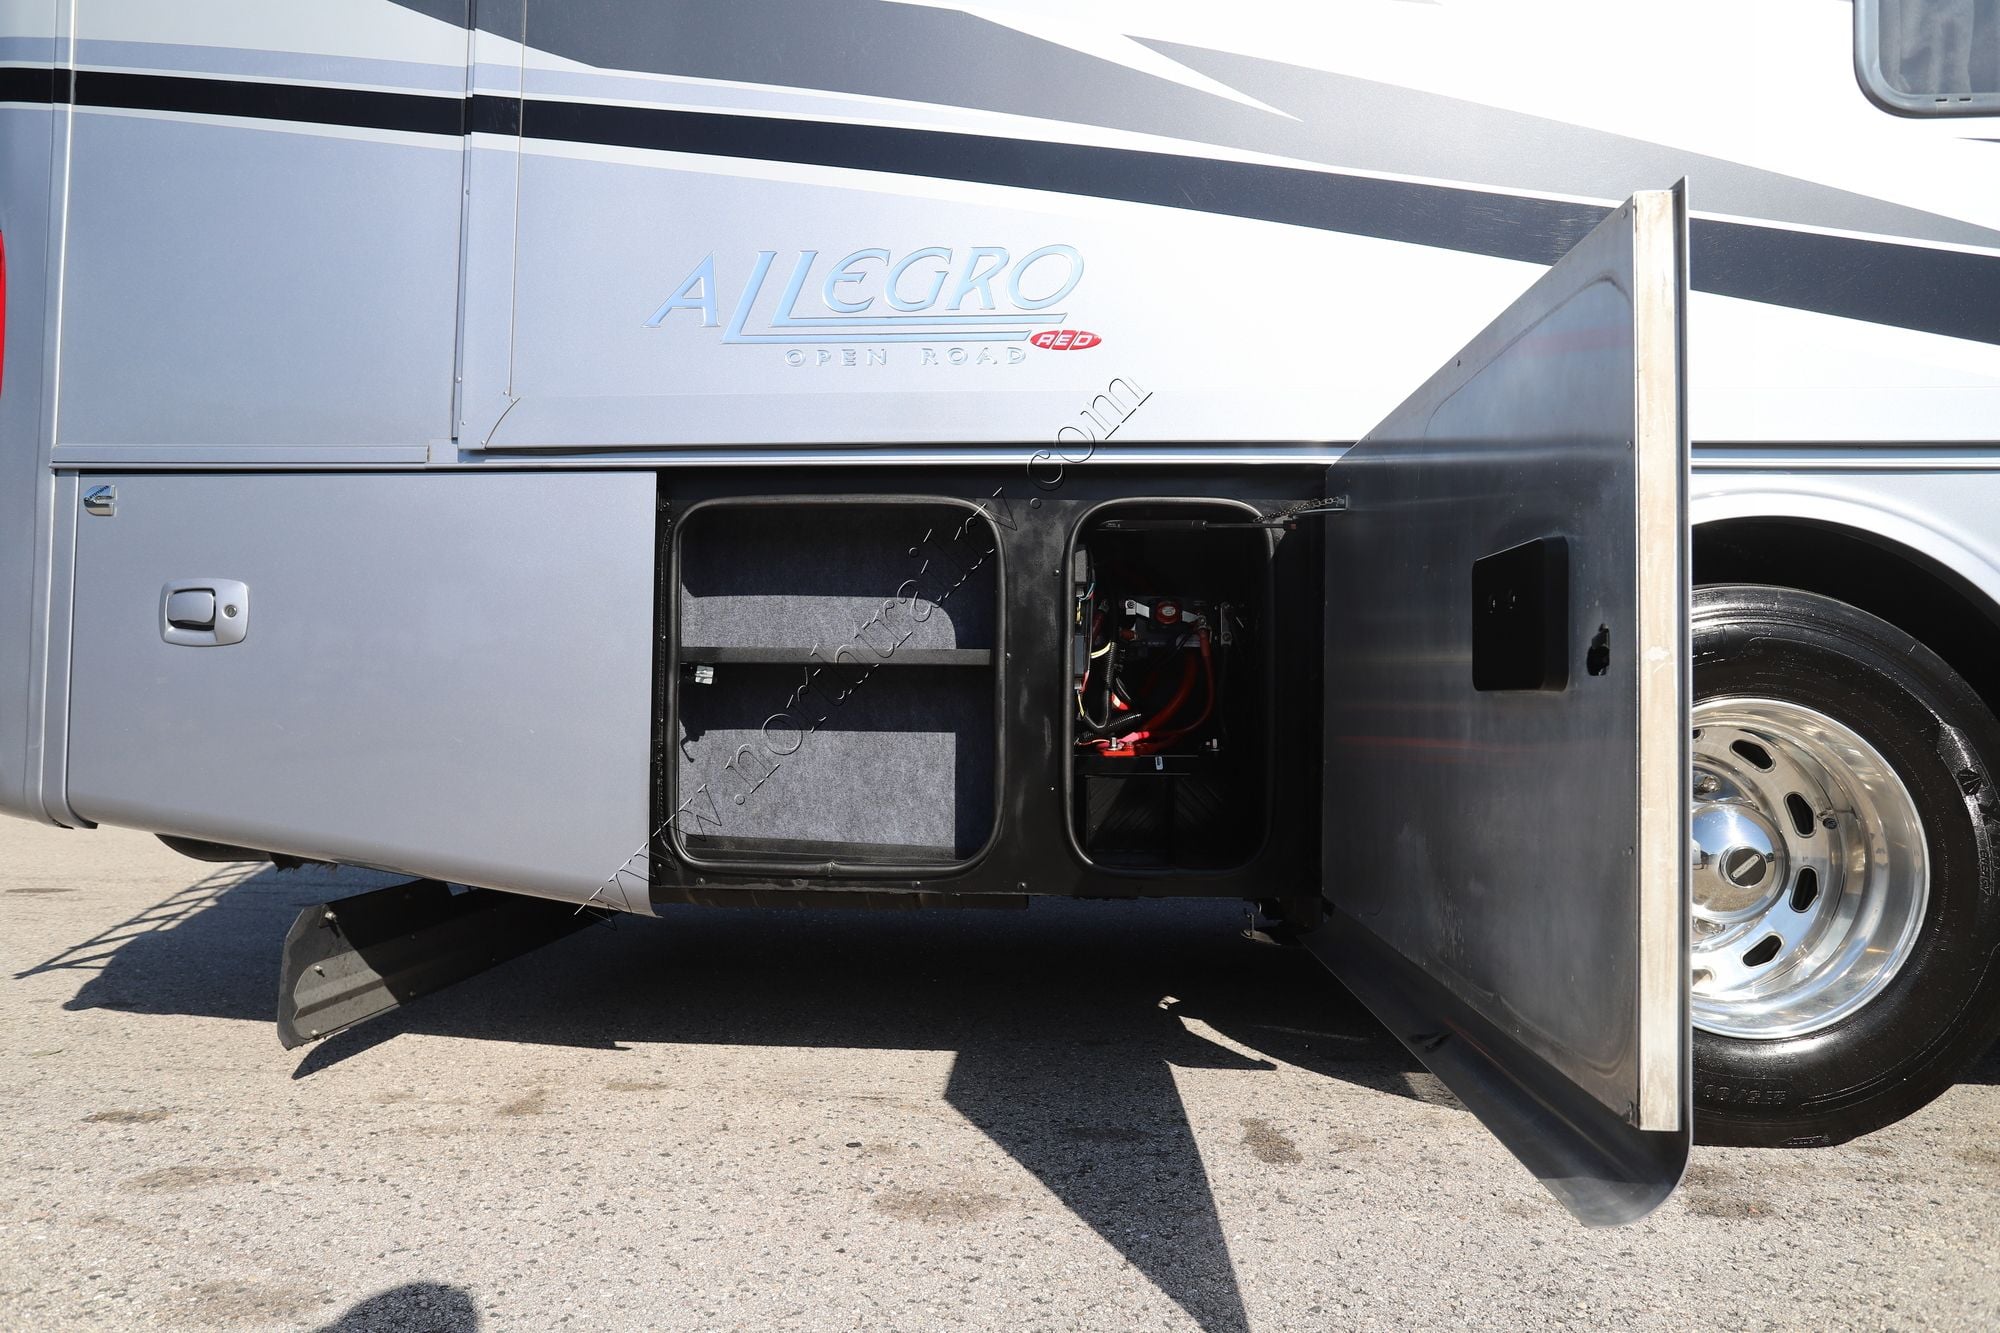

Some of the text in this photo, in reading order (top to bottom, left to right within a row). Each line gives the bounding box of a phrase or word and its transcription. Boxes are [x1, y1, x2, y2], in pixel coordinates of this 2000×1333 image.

[641, 243, 1085, 344] ALLEGRO
[1035, 333, 1094, 347] RED
[785, 346, 1028, 368] OPEN ROAD
